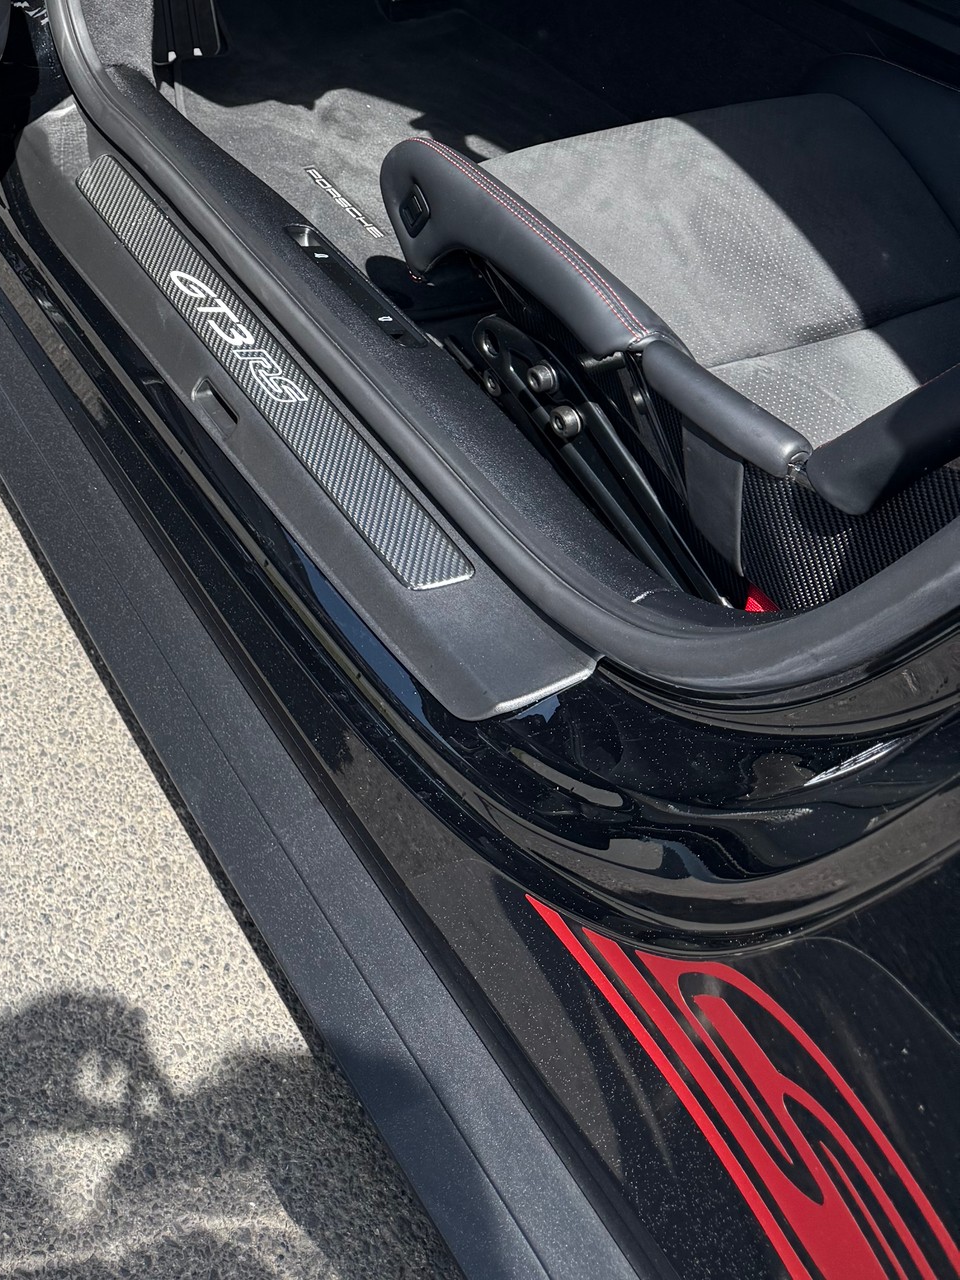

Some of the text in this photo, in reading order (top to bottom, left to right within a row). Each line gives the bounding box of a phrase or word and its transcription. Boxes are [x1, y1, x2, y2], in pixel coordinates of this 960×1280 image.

[303, 165, 385, 239] PORSCHE
[170, 270, 308, 403] GT3 RS
